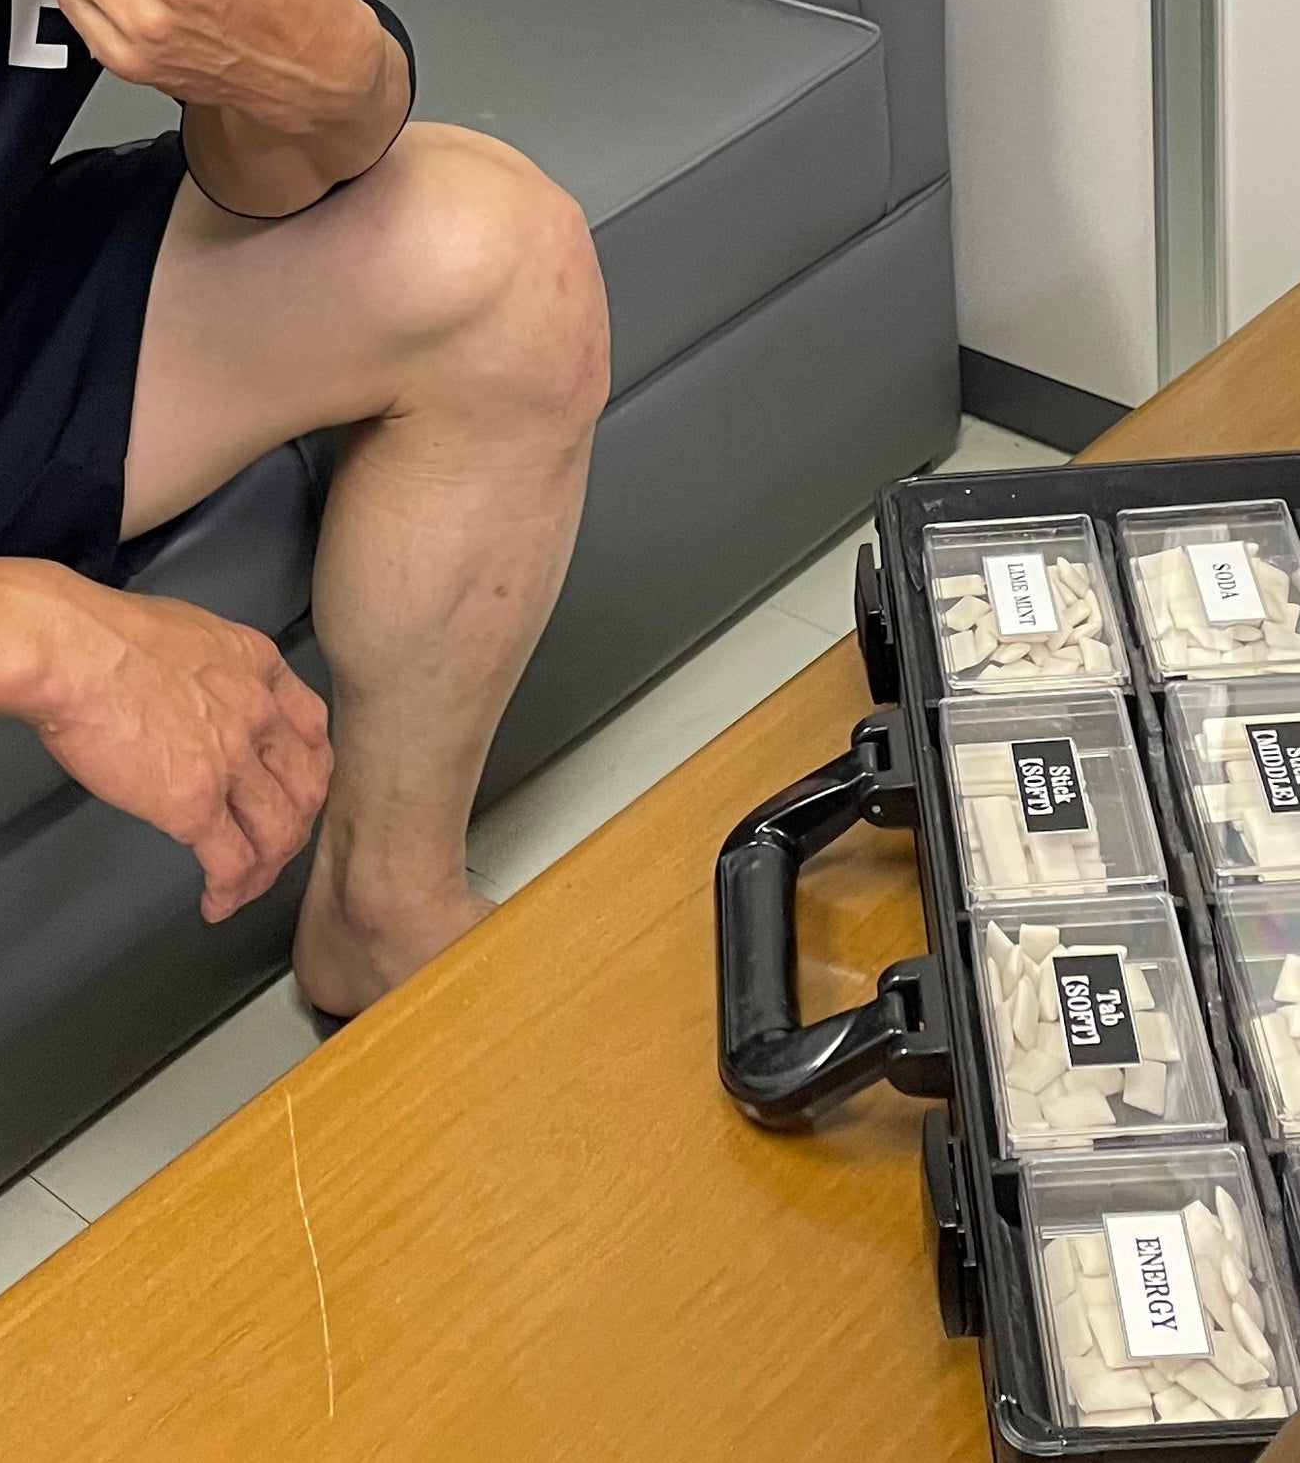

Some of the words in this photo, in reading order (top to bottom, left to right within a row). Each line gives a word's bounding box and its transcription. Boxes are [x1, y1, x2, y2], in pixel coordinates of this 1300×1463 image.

[1007, 562, 1029, 592] LIME
[1211, 562, 1241, 601] SODA
[1013, 594, 1037, 626] MINT
[1049, 765, 1077, 804] Stick
[1096, 988, 1126, 1026] Tab
[1135, 1236, 1178, 1333] ENERGY
